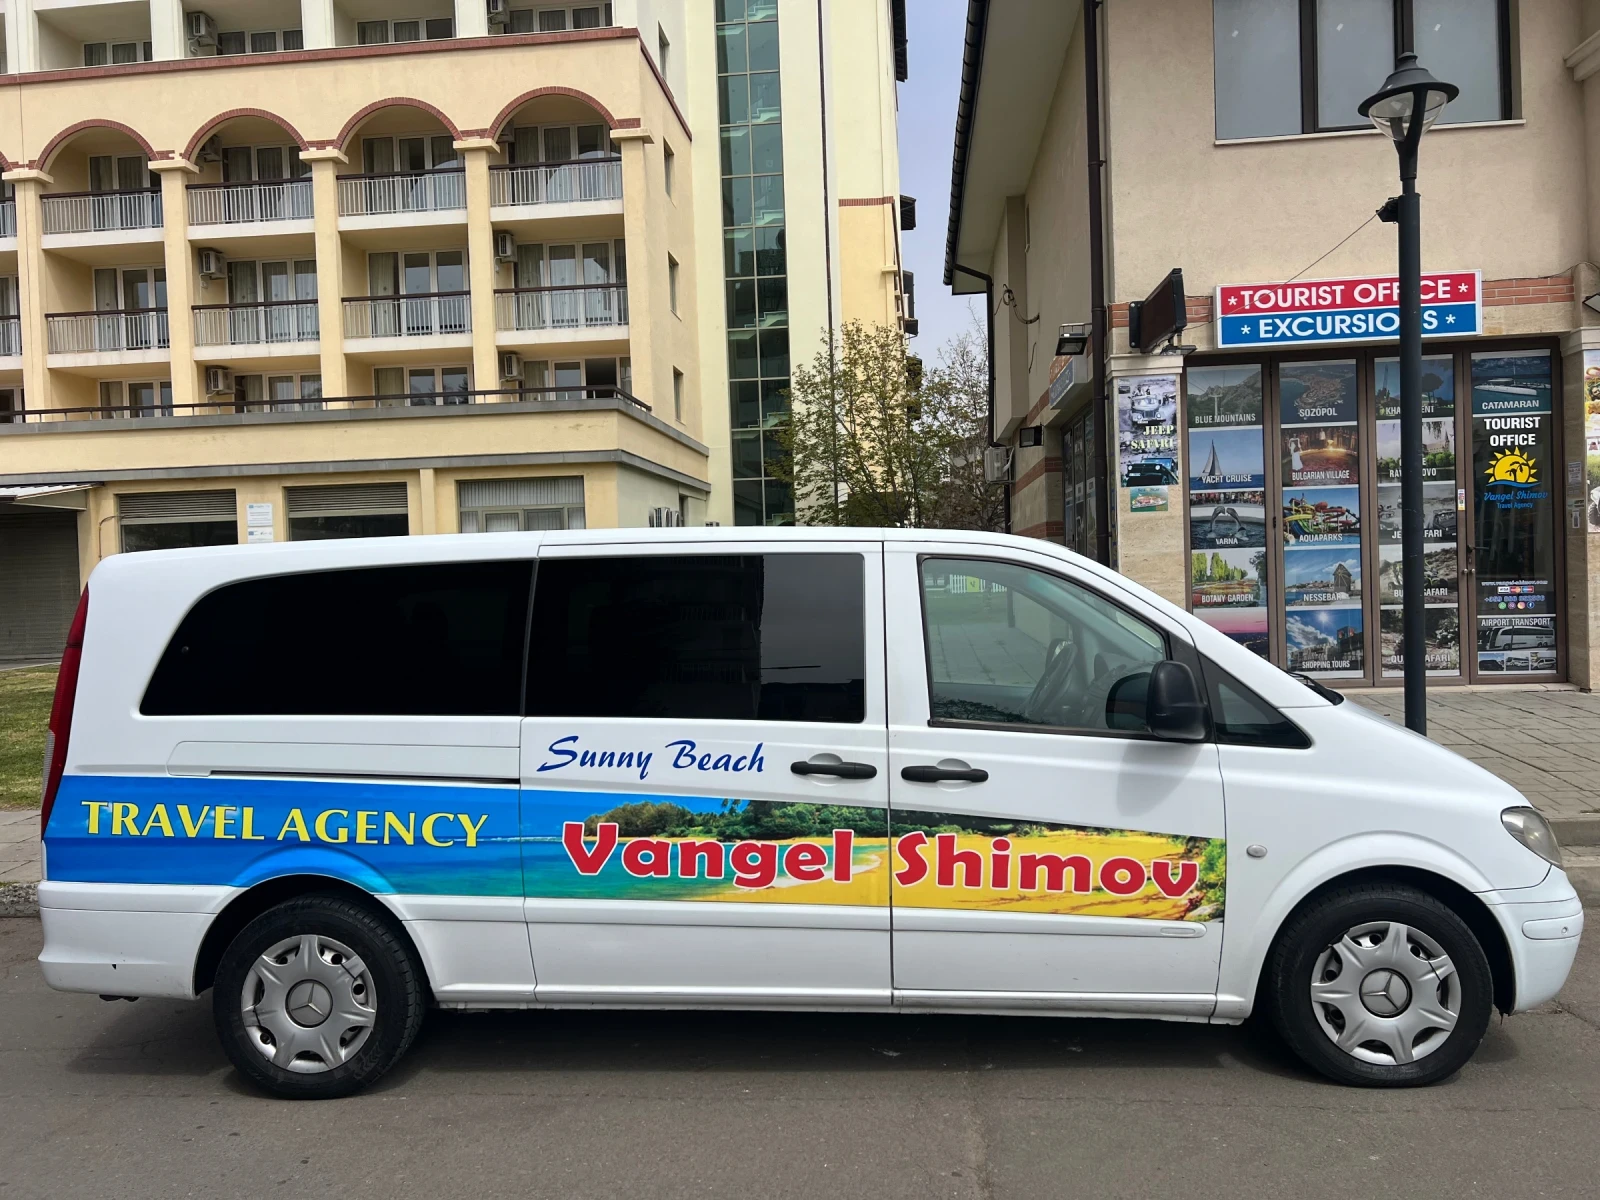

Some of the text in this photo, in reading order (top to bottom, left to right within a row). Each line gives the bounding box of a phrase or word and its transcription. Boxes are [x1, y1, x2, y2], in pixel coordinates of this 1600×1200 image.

[1240, 279, 1451, 310] TOURIST OFFCE
[1259, 309, 1438, 338] EXCURSIOS
[1482, 399, 1539, 410] CATAMARAN
[1299, 408, 1338, 417] SOZOPOL
[1195, 413, 1256, 424] BLUE MOUNTAINS
[1484, 416, 1540, 430] TOURIST
[1143, 425, 1175, 436] JEEP
[1130, 438, 1174, 450] SAFARI
[1489, 433, 1536, 447] OFFICE
[1201, 473, 1252, 484] YACHT CRUISE
[1292, 469, 1350, 481] BULGARIAN VILLAGE
[1483, 490, 1548, 502] Vangel Shimov
[1514, 501, 1533, 509] Agency
[1215, 537, 1238, 545] VARNA
[1299, 533, 1343, 542] AQUAPARKS
[1201, 593, 1254, 603] BOTANY GARDEN
[1303, 592, 1342, 602] NESSEBAR
[1481, 617, 1551, 627] AIRPORT TRANSPORT
[1425, 653, 1450, 662] AFARI
[1302, 660, 1350, 669] SHOPPING TOURS
[536, 735, 765, 781] Sunny Beach
[80, 799, 489, 848] TRAVEL AGENCY
[561, 822, 1198, 899] Vangel Shimov
